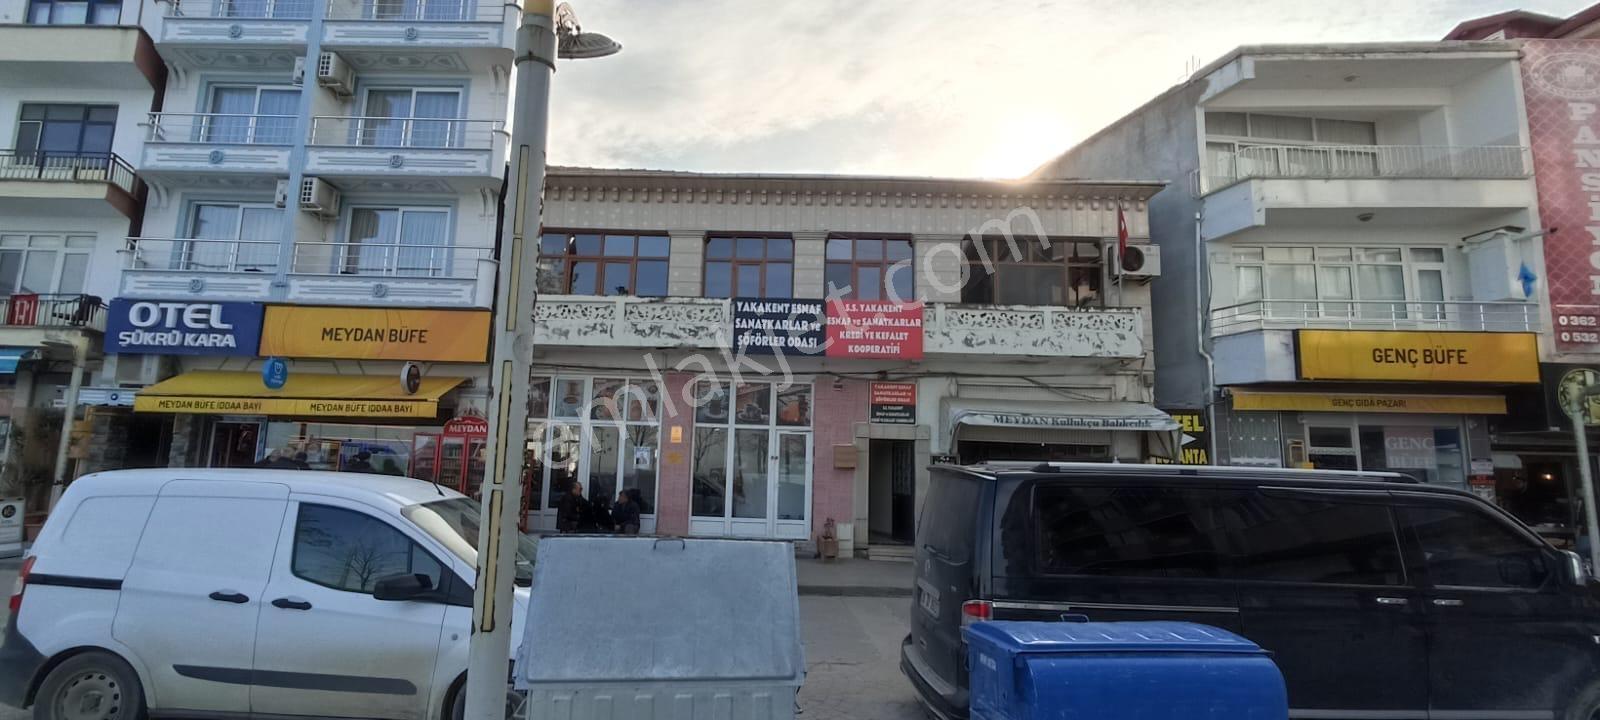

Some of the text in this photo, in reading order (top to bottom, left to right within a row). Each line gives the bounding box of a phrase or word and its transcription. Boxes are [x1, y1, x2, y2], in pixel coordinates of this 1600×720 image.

[736, 301, 822, 315] YAKAKENT ESNAF
[860, 304, 904, 313] YAKAKENT
[128, 301, 233, 330] OTEL
[827, 316, 852, 326] ESNAF
[862, 317, 922, 327] SANATKARLAR
[1558, 315, 1597, 326] 0 362
[735, 317, 821, 331] SANATKARLAR ve
[118, 329, 237, 348] ŞÜKRÜ KARA
[321, 325, 428, 344] MEYDAN BÜFE
[839, 328, 864, 340] KREDİ
[875, 331, 909, 341] KEFALET
[1561, 331, 1599, 343] 0 532
[787, 336, 818, 349] ODASI
[1372, 345, 1468, 368] GENÇ BÜFE
[158, 400, 193, 409] MEYDAN
[310, 403, 343, 412] MEYDAN
[1376, 399, 1407, 409] PAZARI
[993, 414, 1049, 426] MEYDAN
[1171, 414, 1205, 432] TEL
[449, 424, 487, 433] MEYDAN
